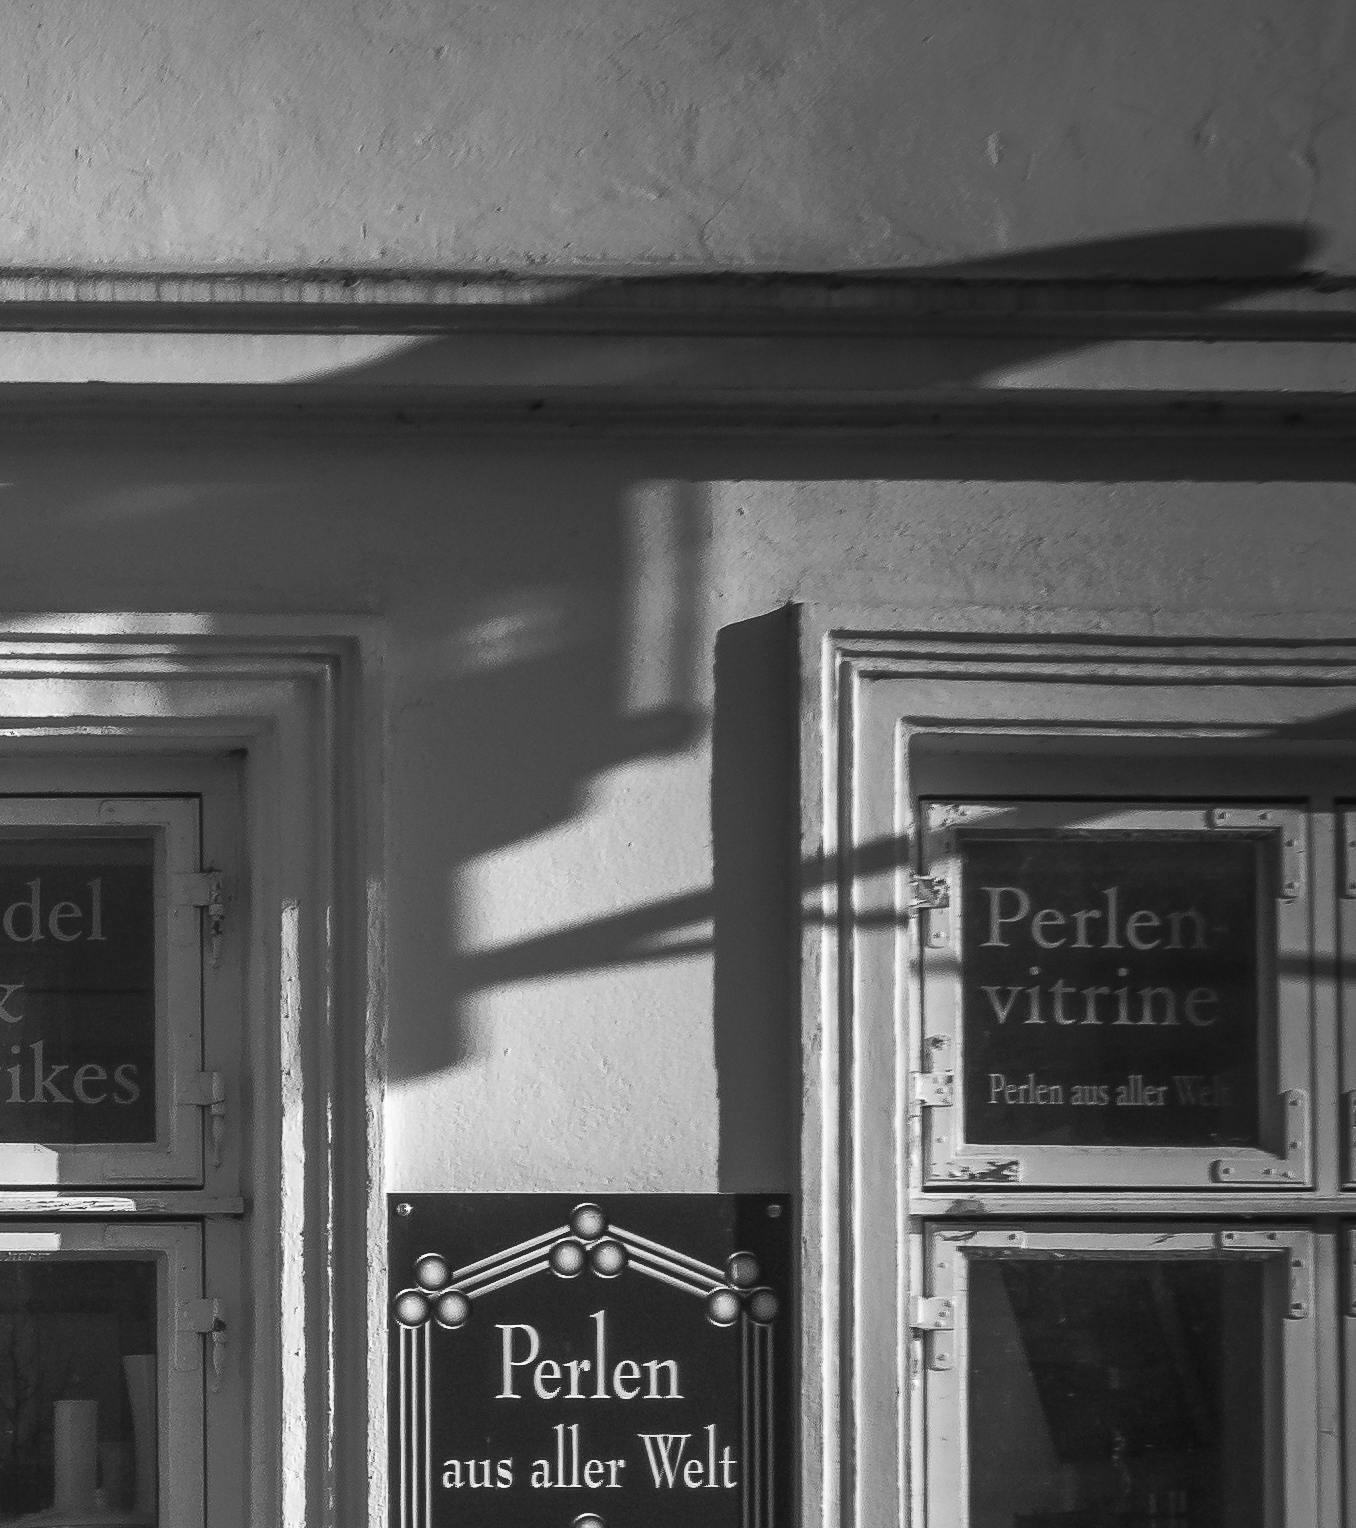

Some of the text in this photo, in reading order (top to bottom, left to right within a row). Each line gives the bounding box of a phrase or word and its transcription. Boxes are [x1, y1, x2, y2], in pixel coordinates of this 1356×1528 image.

[980, 966, 1218, 1028] vitrine
[987, 1073, 1064, 1105] Perlen
[1071, 1085, 1108, 1105] aus
[1115, 1074, 1168, 1106] aller
[494, 1309, 685, 1400] Perlen
[442, 1423, 737, 1489] aus aller Welt
